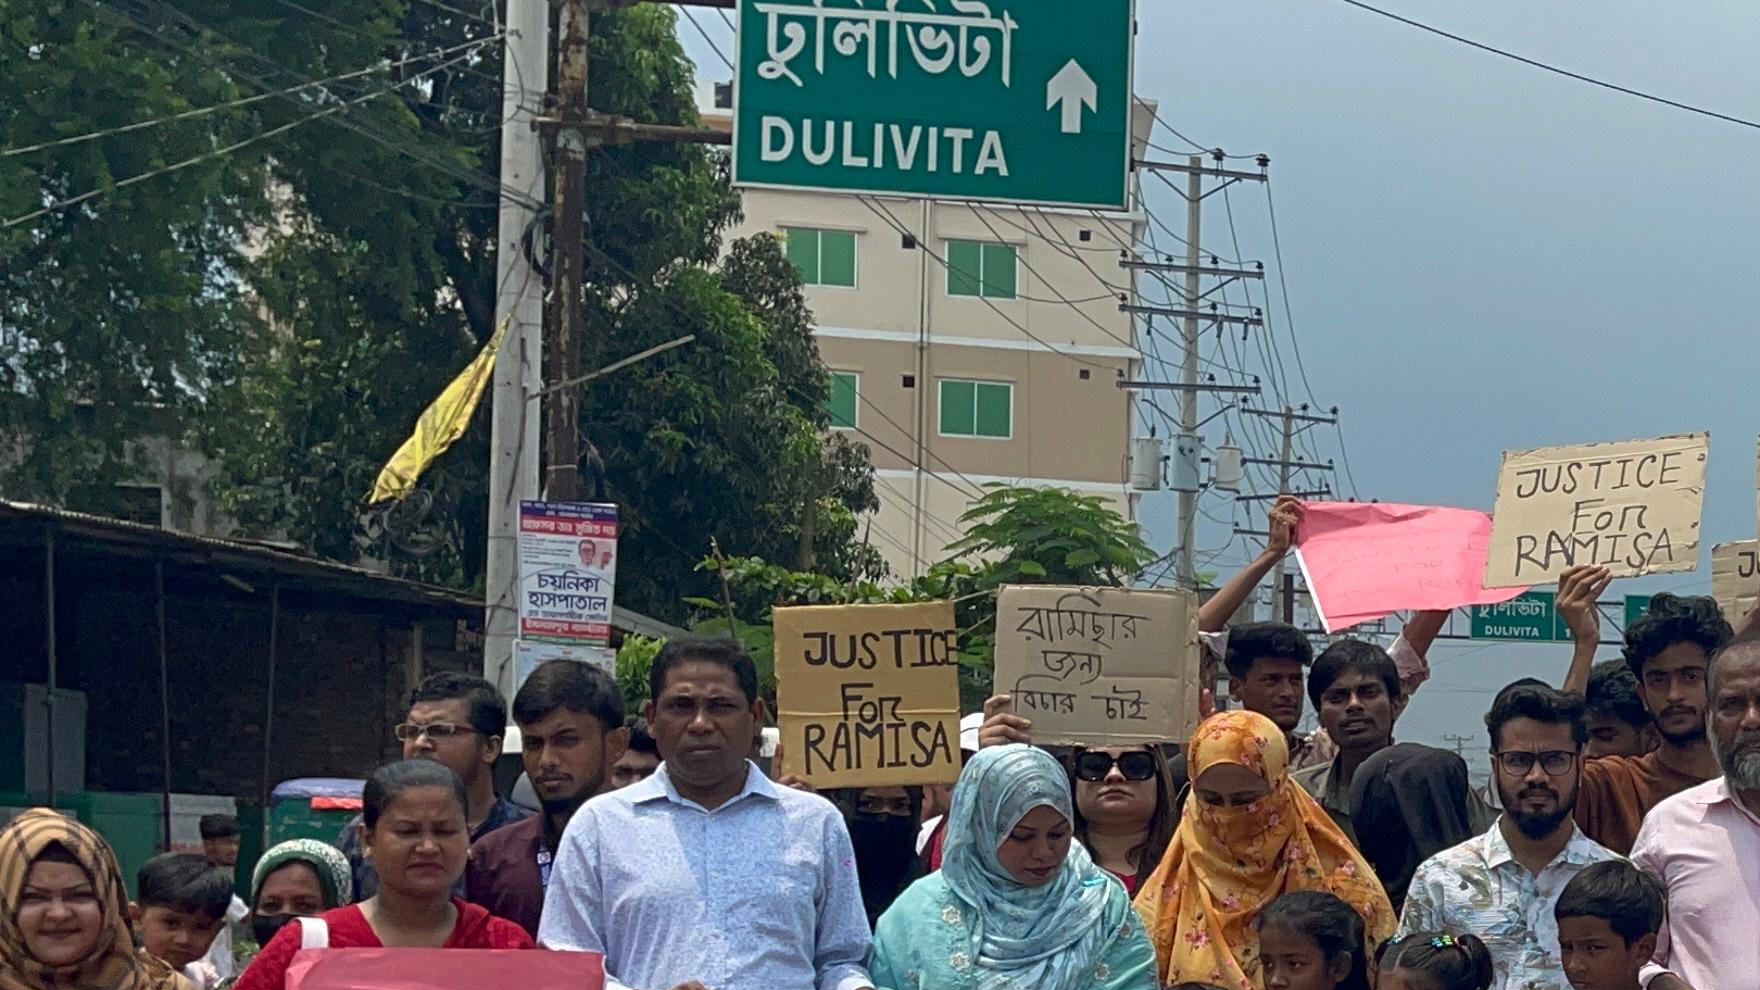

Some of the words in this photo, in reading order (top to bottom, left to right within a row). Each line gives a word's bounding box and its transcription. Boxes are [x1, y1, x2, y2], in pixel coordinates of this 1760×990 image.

[754, 0, 1019, 88] ঢুলিভিটা
[761, 116, 1009, 177] DULIVITA
[1516, 452, 1683, 498] JUSTICE
[1515, 527, 1674, 577] RAMISA
[528, 590, 607, 612] হাসপাতাল
[537, 570, 599, 592] চয়নিকা
[803, 628, 958, 670] JUSTICE
[1485, 625, 1540, 638] DULIVITA
[1041, 649, 1105, 685] জন্য
[1011, 673, 1078, 714] বিচার
[1090, 685, 1150, 721] চাই
[804, 720, 953, 775] RAMISA
